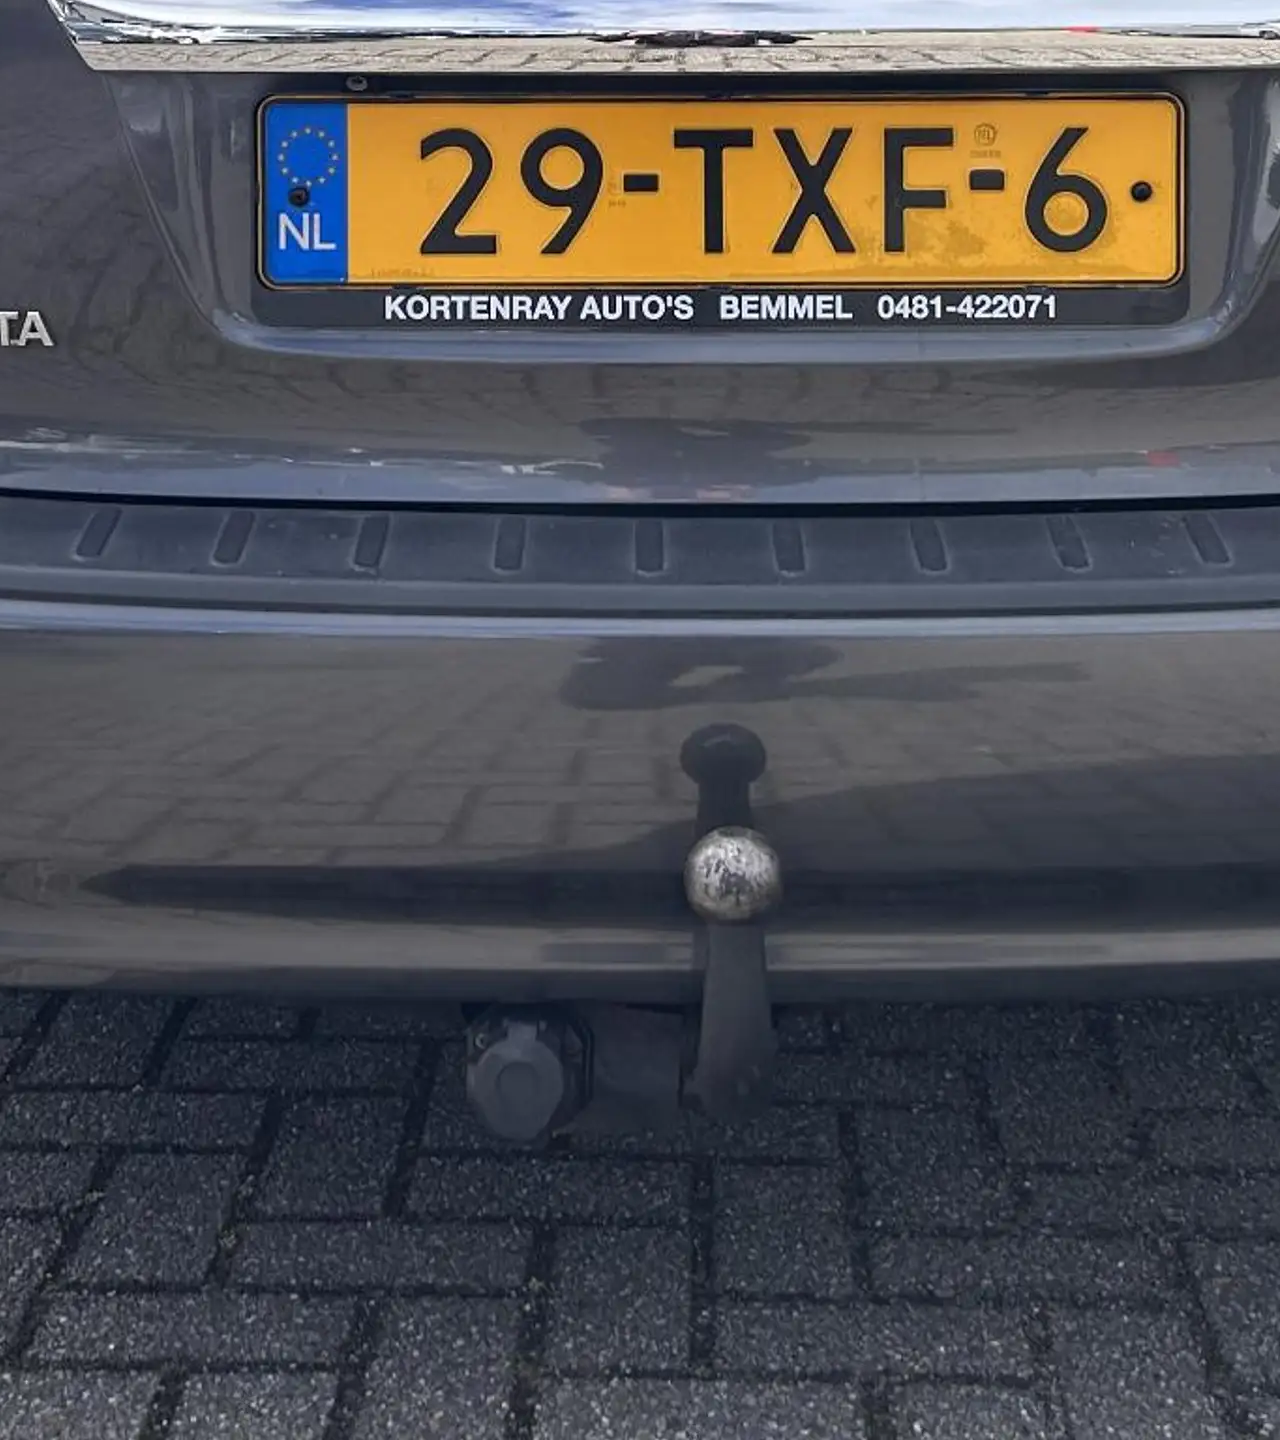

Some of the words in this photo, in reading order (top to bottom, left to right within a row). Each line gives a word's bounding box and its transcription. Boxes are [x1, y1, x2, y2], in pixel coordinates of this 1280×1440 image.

[419, 127, 1109, 256] 29-TXF-6
[278, 212, 337, 251] NL
[384, 294, 573, 321] KORTENRAY
[579, 294, 695, 321] AUTO'S
[719, 294, 854, 321] BEMMEL
[877, 294, 1057, 321] 0481-422071
